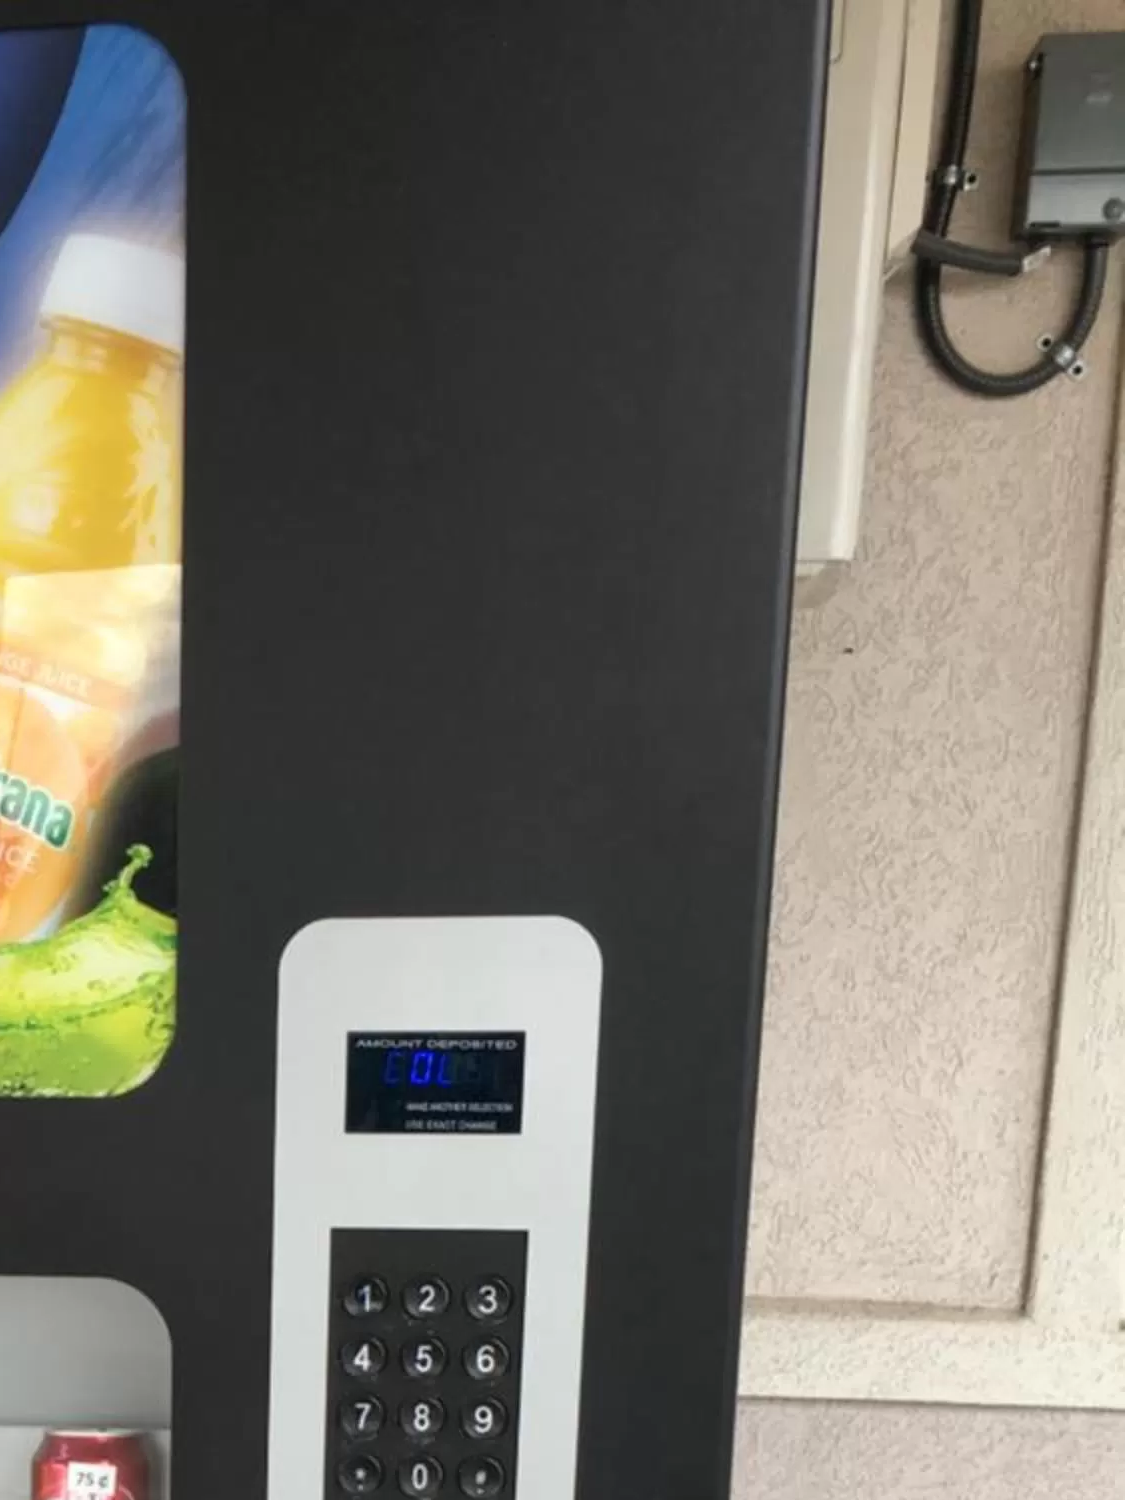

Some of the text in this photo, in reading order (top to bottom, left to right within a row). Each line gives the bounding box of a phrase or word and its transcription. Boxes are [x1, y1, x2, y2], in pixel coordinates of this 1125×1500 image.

[355, 1038, 518, 1050] AMOUNT DEPOSITED
[359, 1284, 497, 1313] 1 2 3
[353, 1343, 496, 1373] 4 5 6
[354, 1402, 494, 1434] 7 8 9
[411, 1463, 429, 1490] 0
